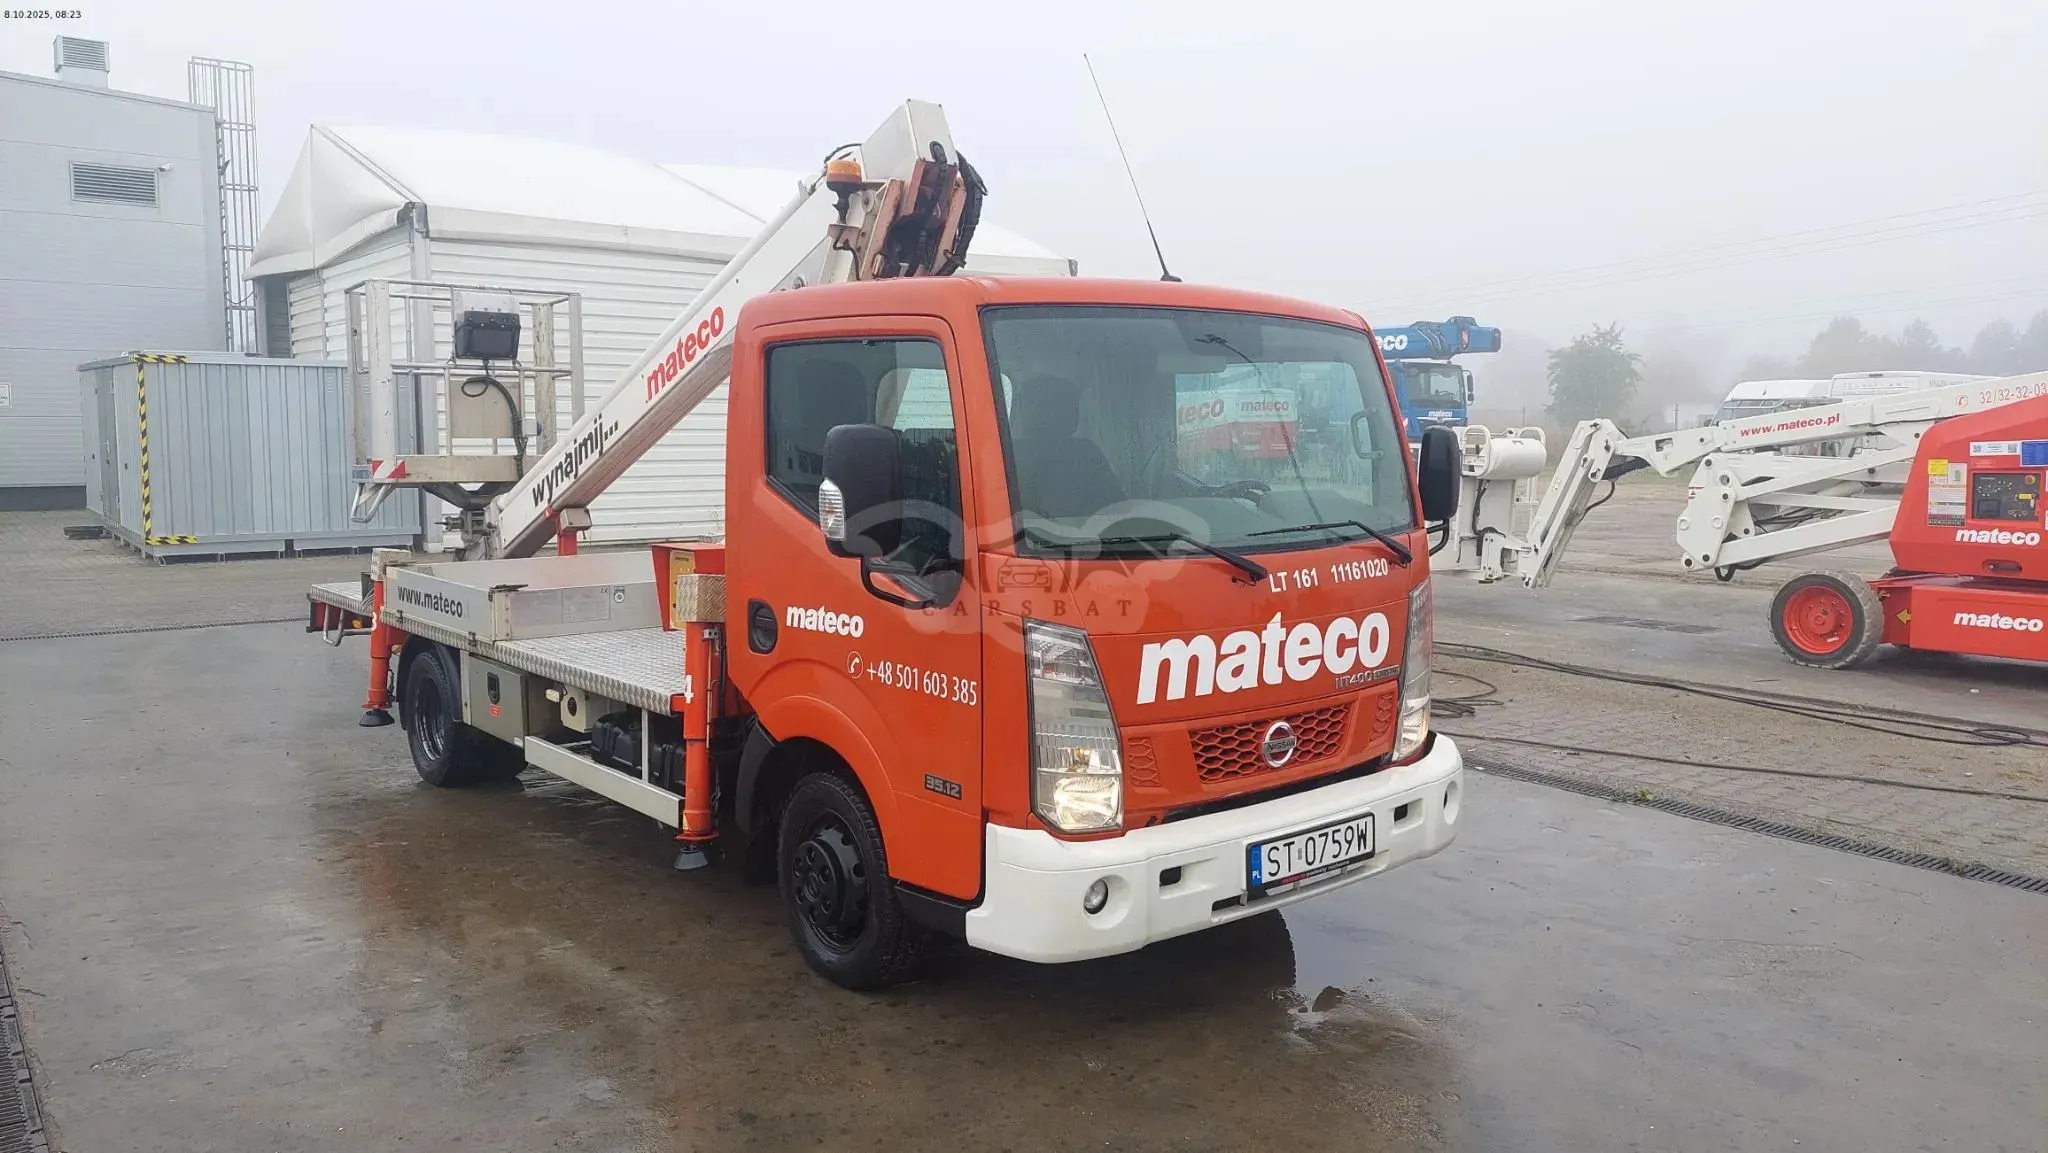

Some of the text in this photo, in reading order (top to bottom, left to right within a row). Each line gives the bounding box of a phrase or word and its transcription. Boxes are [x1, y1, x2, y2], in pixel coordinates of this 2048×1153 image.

[646, 306, 724, 401] mateco
[1240, 396, 1289, 412] mateco
[1428, 410, 1453, 418] mateco
[1740, 413, 1840, 437] www.mateco.pl
[1955, 528, 2041, 546] mateco
[1269, 558, 1388, 593] LT 161 11161020
[397, 586, 463, 618] www.mateco
[786, 605, 865, 638] mateco
[1953, 612, 2044, 632] mateco
[1137, 612, 1390, 705] mateco
[866, 660, 977, 706] +48 501 603 385
[1267, 738, 1296, 750] NISSAN
[926, 775, 961, 798] 35.12
[1267, 821, 1368, 877] ST 0759W
[1252, 871, 1261, 879] PL
